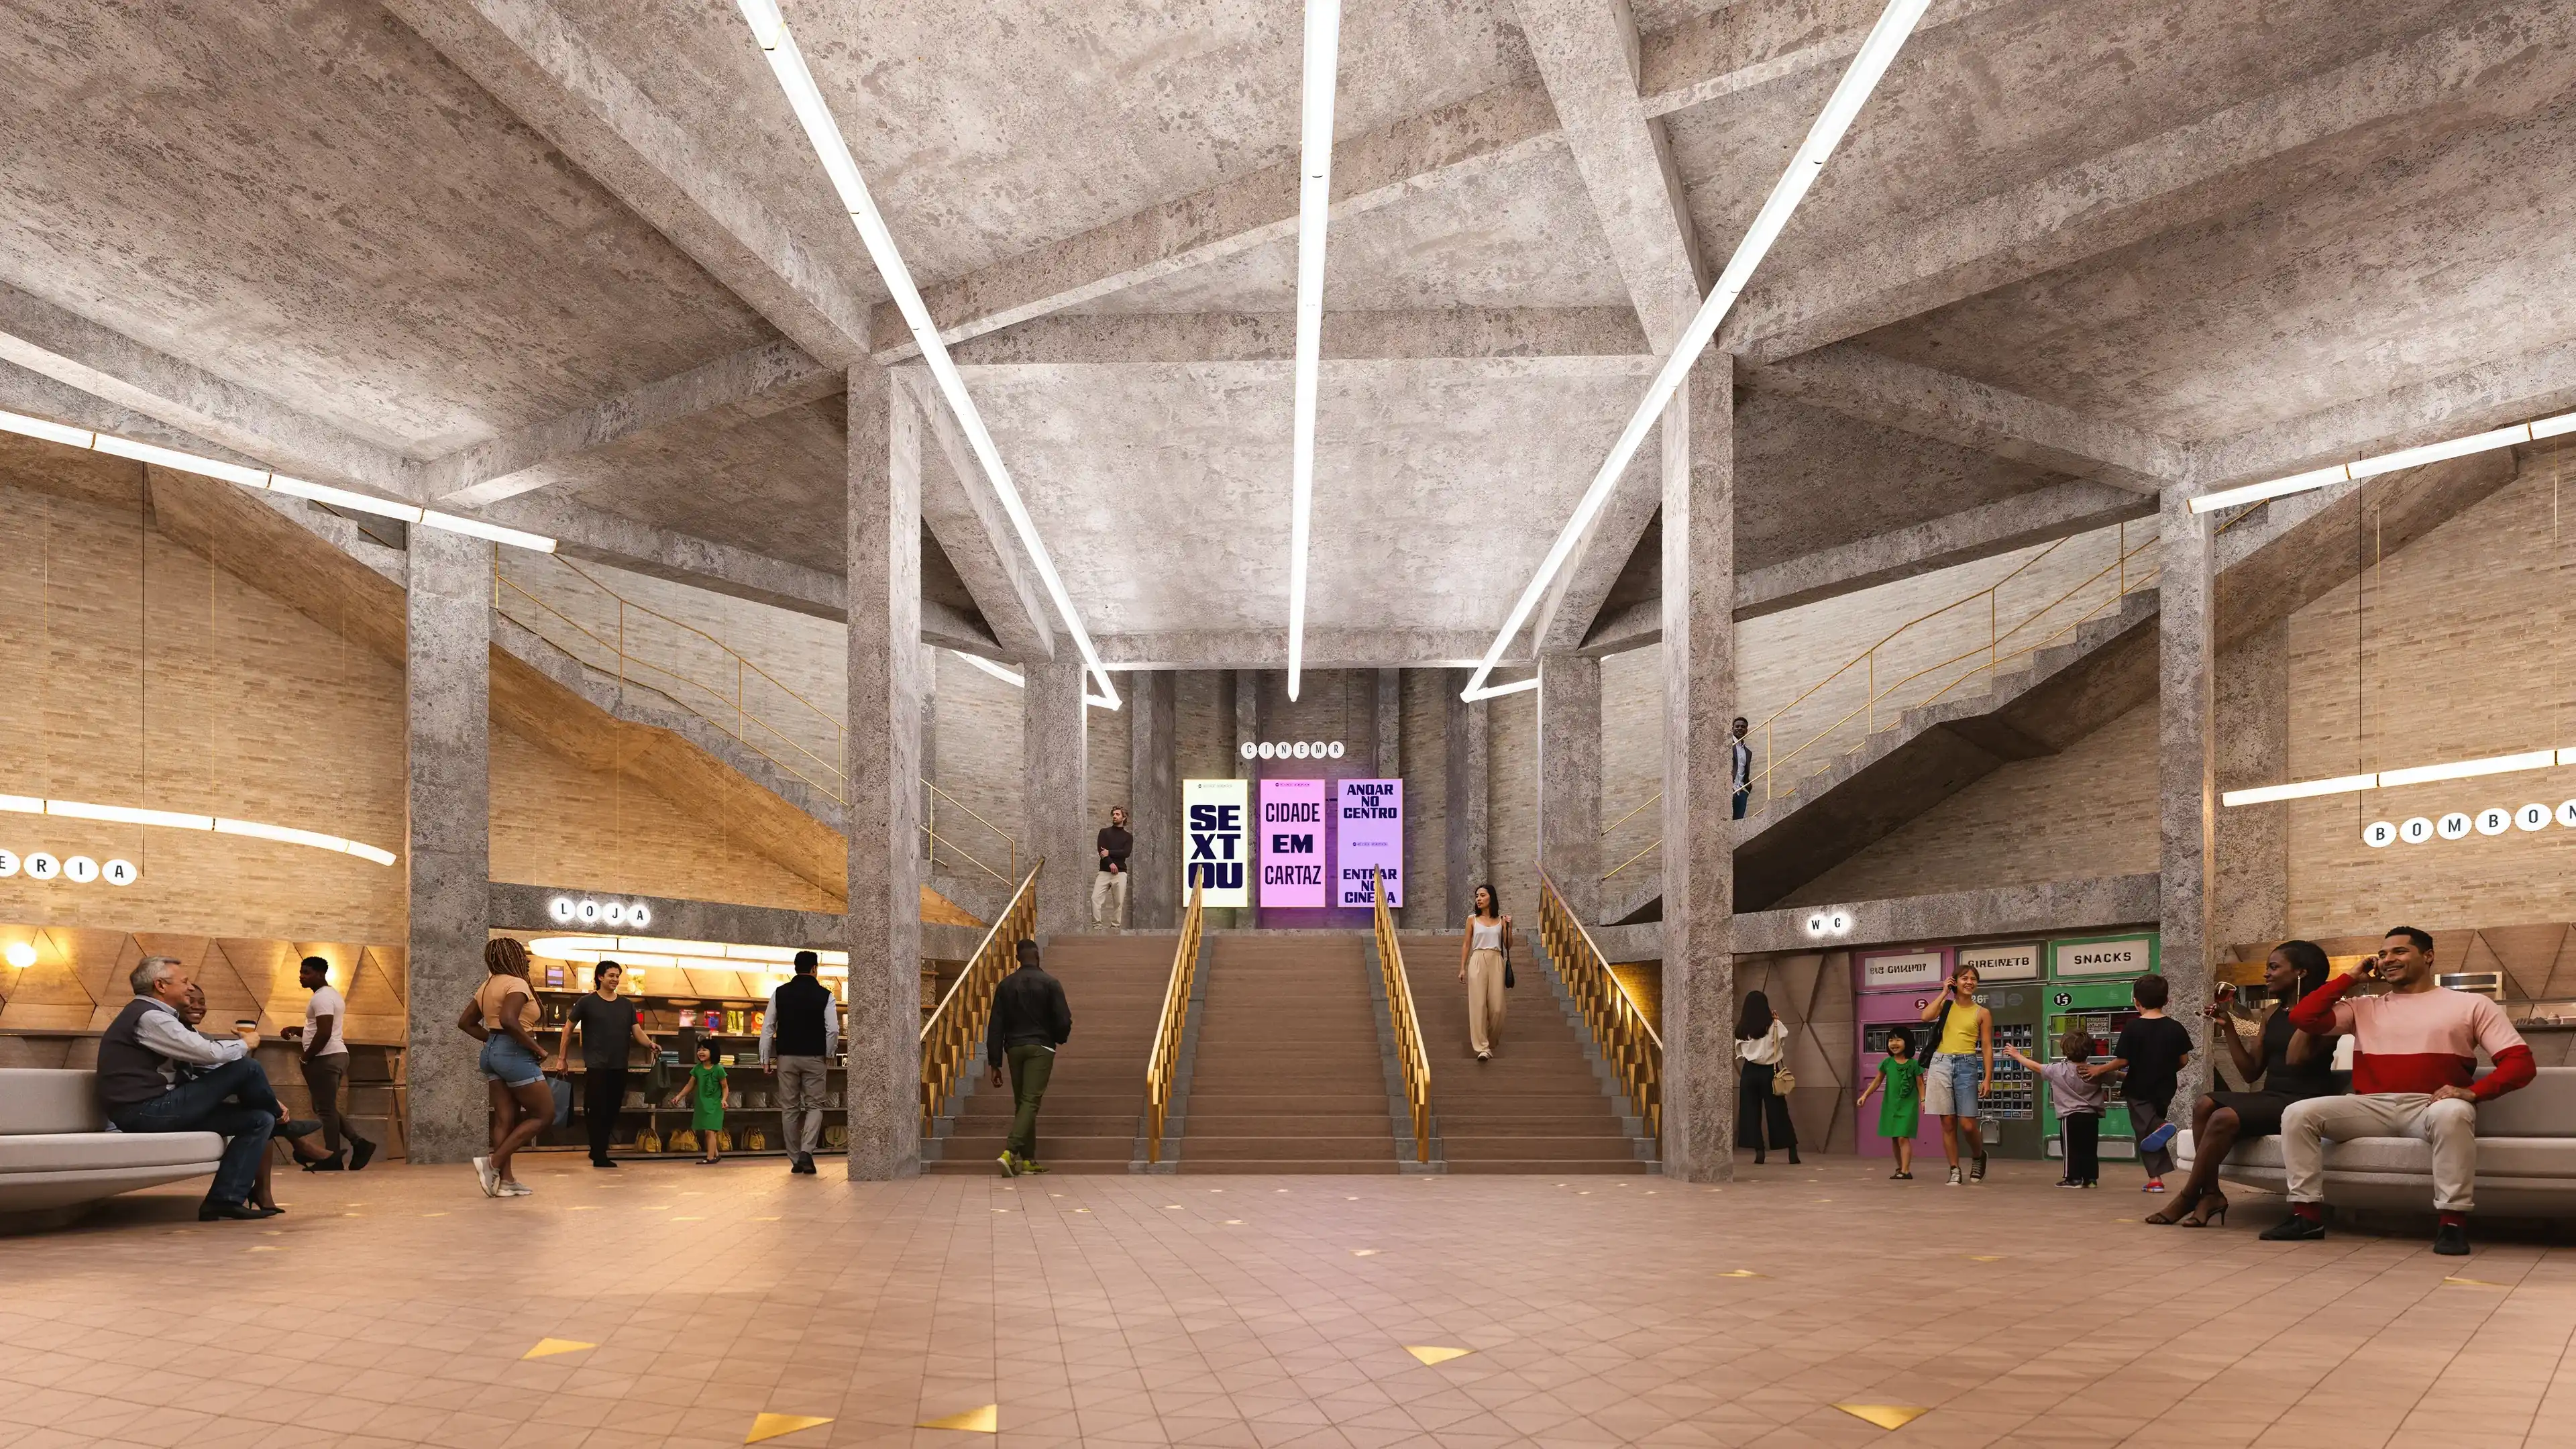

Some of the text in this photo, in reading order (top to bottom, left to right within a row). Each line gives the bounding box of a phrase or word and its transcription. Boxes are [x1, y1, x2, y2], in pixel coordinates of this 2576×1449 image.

[1361, 796, 1379, 807] NO
[1190, 804, 1241, 831] SE
[1265, 802, 1320, 822] CIDADE
[1343, 807, 1397, 819] CENTRO
[1190, 833, 1241, 860] XT
[1273, 834, 1313, 853] EM
[1188, 862, 1243, 889] OU
[1265, 865, 1322, 885] CARTAZ
[1344, 892, 1397, 904] CINEA
[561, 902, 644, 921] LOJA
[2074, 951, 2132, 965] SNACKS
[1918, 999, 1926, 1010] 5
